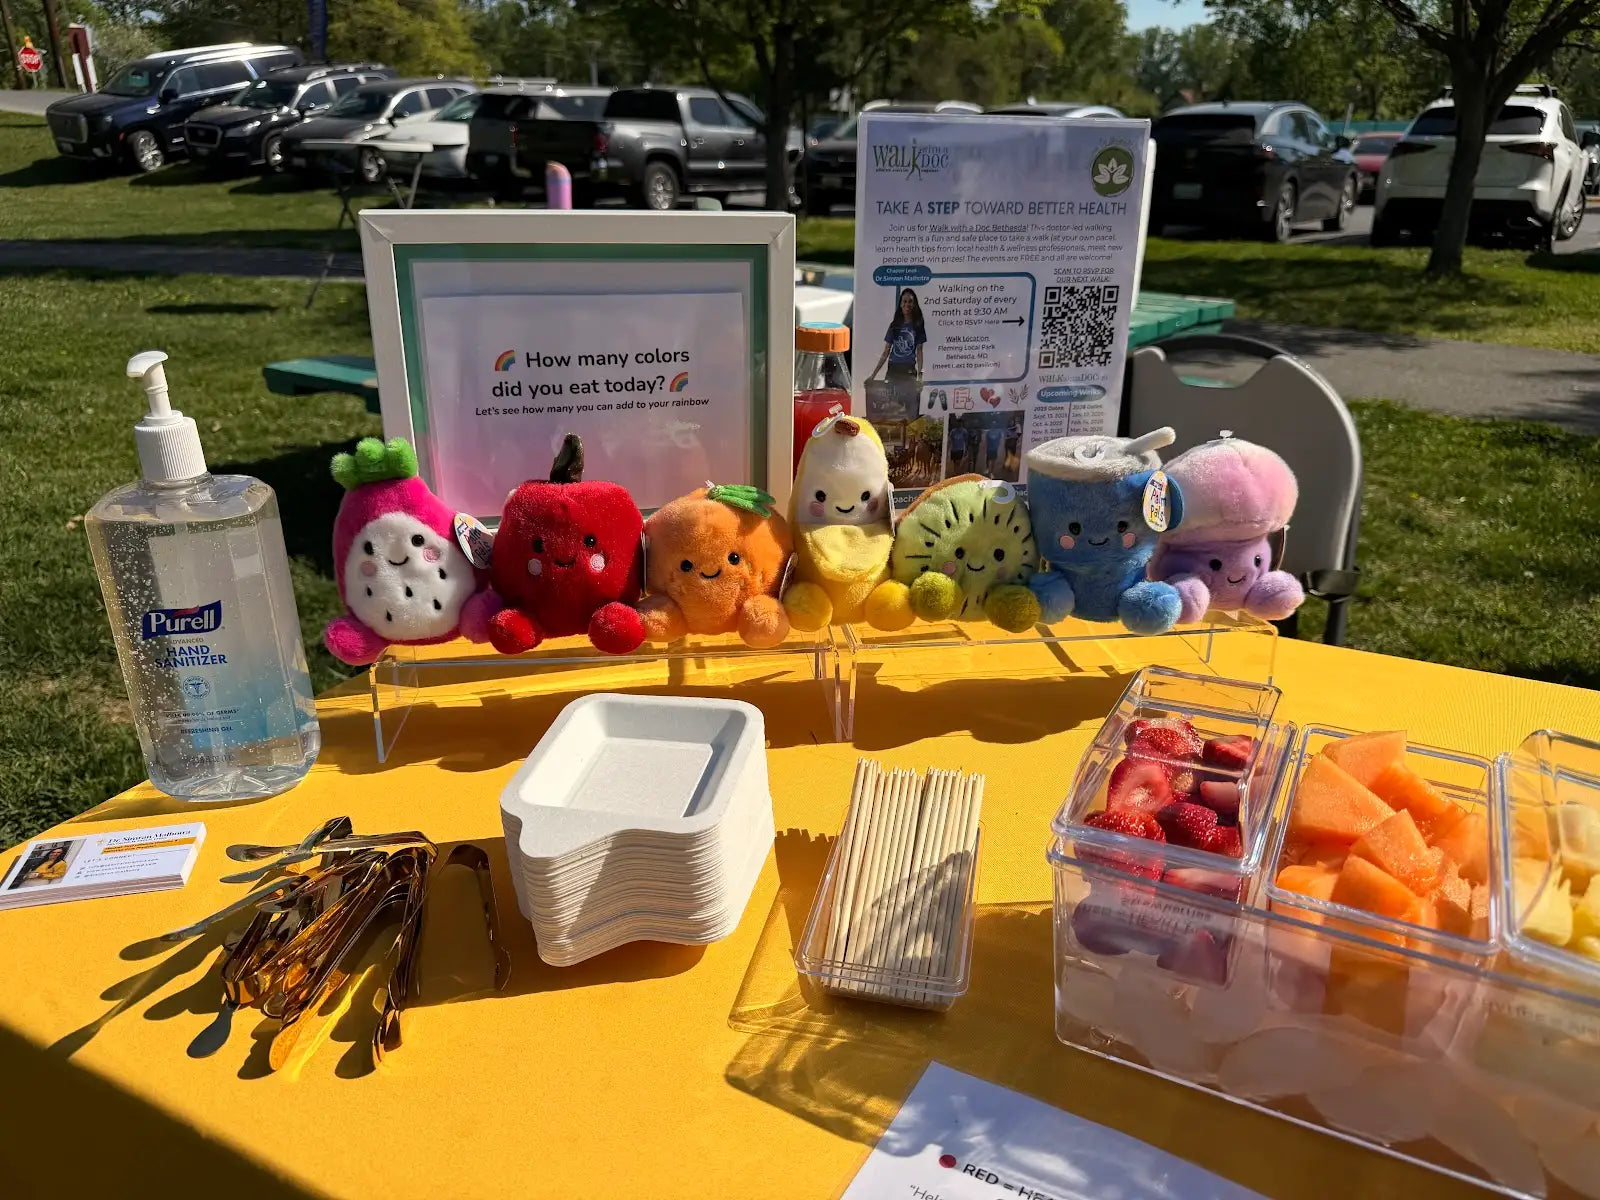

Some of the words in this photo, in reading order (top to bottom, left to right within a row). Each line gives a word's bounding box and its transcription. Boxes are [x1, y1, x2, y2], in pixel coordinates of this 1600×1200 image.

[21, 54, 41, 64] STOP
[921, 153, 949, 168] DOC
[876, 201, 910, 215] TAKE
[914, 201, 923, 215] A
[928, 201, 960, 214] STEP
[964, 201, 1024, 215] TOWARD
[1028, 201, 1075, 215] BETTER
[1079, 201, 1127, 215] HEALTH
[889, 224, 906, 232] Join
[917, 224, 928, 232] for
[929, 224, 949, 233] Walk
[950, 224, 968, 233] with
[975, 224, 991, 233] Doc
[992, 224, 1029, 233] Bethesda!
[1085, 224, 1113, 233] walking
[882, 235, 916, 244] program
[961, 234, 977, 242] safe
[978, 234, 998, 243] place
[1008, 234, 1025, 242] take
[1032, 234, 1049, 242] walk
[1061, 235, 1079, 243] your
[875, 245, 894, 253] learn
[896, 245, 920, 253] health
[921, 245, 936, 254] tips
[956, 244, 974, 252] local
[975, 244, 999, 252] health
[1006, 244, 1037, 252] wellness
[882, 255, 909, 264] people
[910, 255, 925, 263] and
[941, 255, 965, 264] prizes!
[1041, 254, 1055, 262] and
[1079, 253, 1113, 261] welcome!
[1072, 267, 1082, 275] TO
[1056, 276, 1071, 284] OUR
[1072, 275, 1089, 283] NEXT
[938, 284, 975, 294] Walking
[976, 285, 988, 293] on
[989, 284, 1005, 292] the
[923, 297, 941, 305] 2nd
[942, 296, 982, 306] Saturday
[983, 296, 992, 304] of
[993, 297, 1018, 305] every
[932, 308, 961, 317] month
[963, 308, 973, 316] at
[974, 308, 992, 316] 9:30
[993, 307, 1008, 315] AM
[938, 319, 955, 327] Click
[938, 344, 963, 352] Fleming
[525, 351, 572, 368] How
[577, 352, 630, 369] many
[634, 347, 690, 364] colors
[492, 381, 522, 398] did
[528, 383, 563, 400] you
[569, 379, 600, 395] eat
[604, 375, 666, 395] today?
[1040, 390, 1078, 398] Upcoming
[475, 406, 500, 416] Let's
[502, 407, 520, 415] see
[522, 404, 544, 414] how
[547, 405, 574, 415] many
[576, 404, 594, 414] you
[596, 402, 613, 411] can
[615, 400, 634, 410] add
[636, 400, 646, 409] to
[649, 399, 670, 410] your
[671, 397, 710, 408] rainbow
[148, 609, 215, 633] Purell
[166, 645, 211, 658] HAND
[154, 654, 228, 669] SANITIZER
[180, 726, 220, 735] REFRESHING
[221, 725, 234, 733] GEL
[962, 1163, 999, 1186] RED
